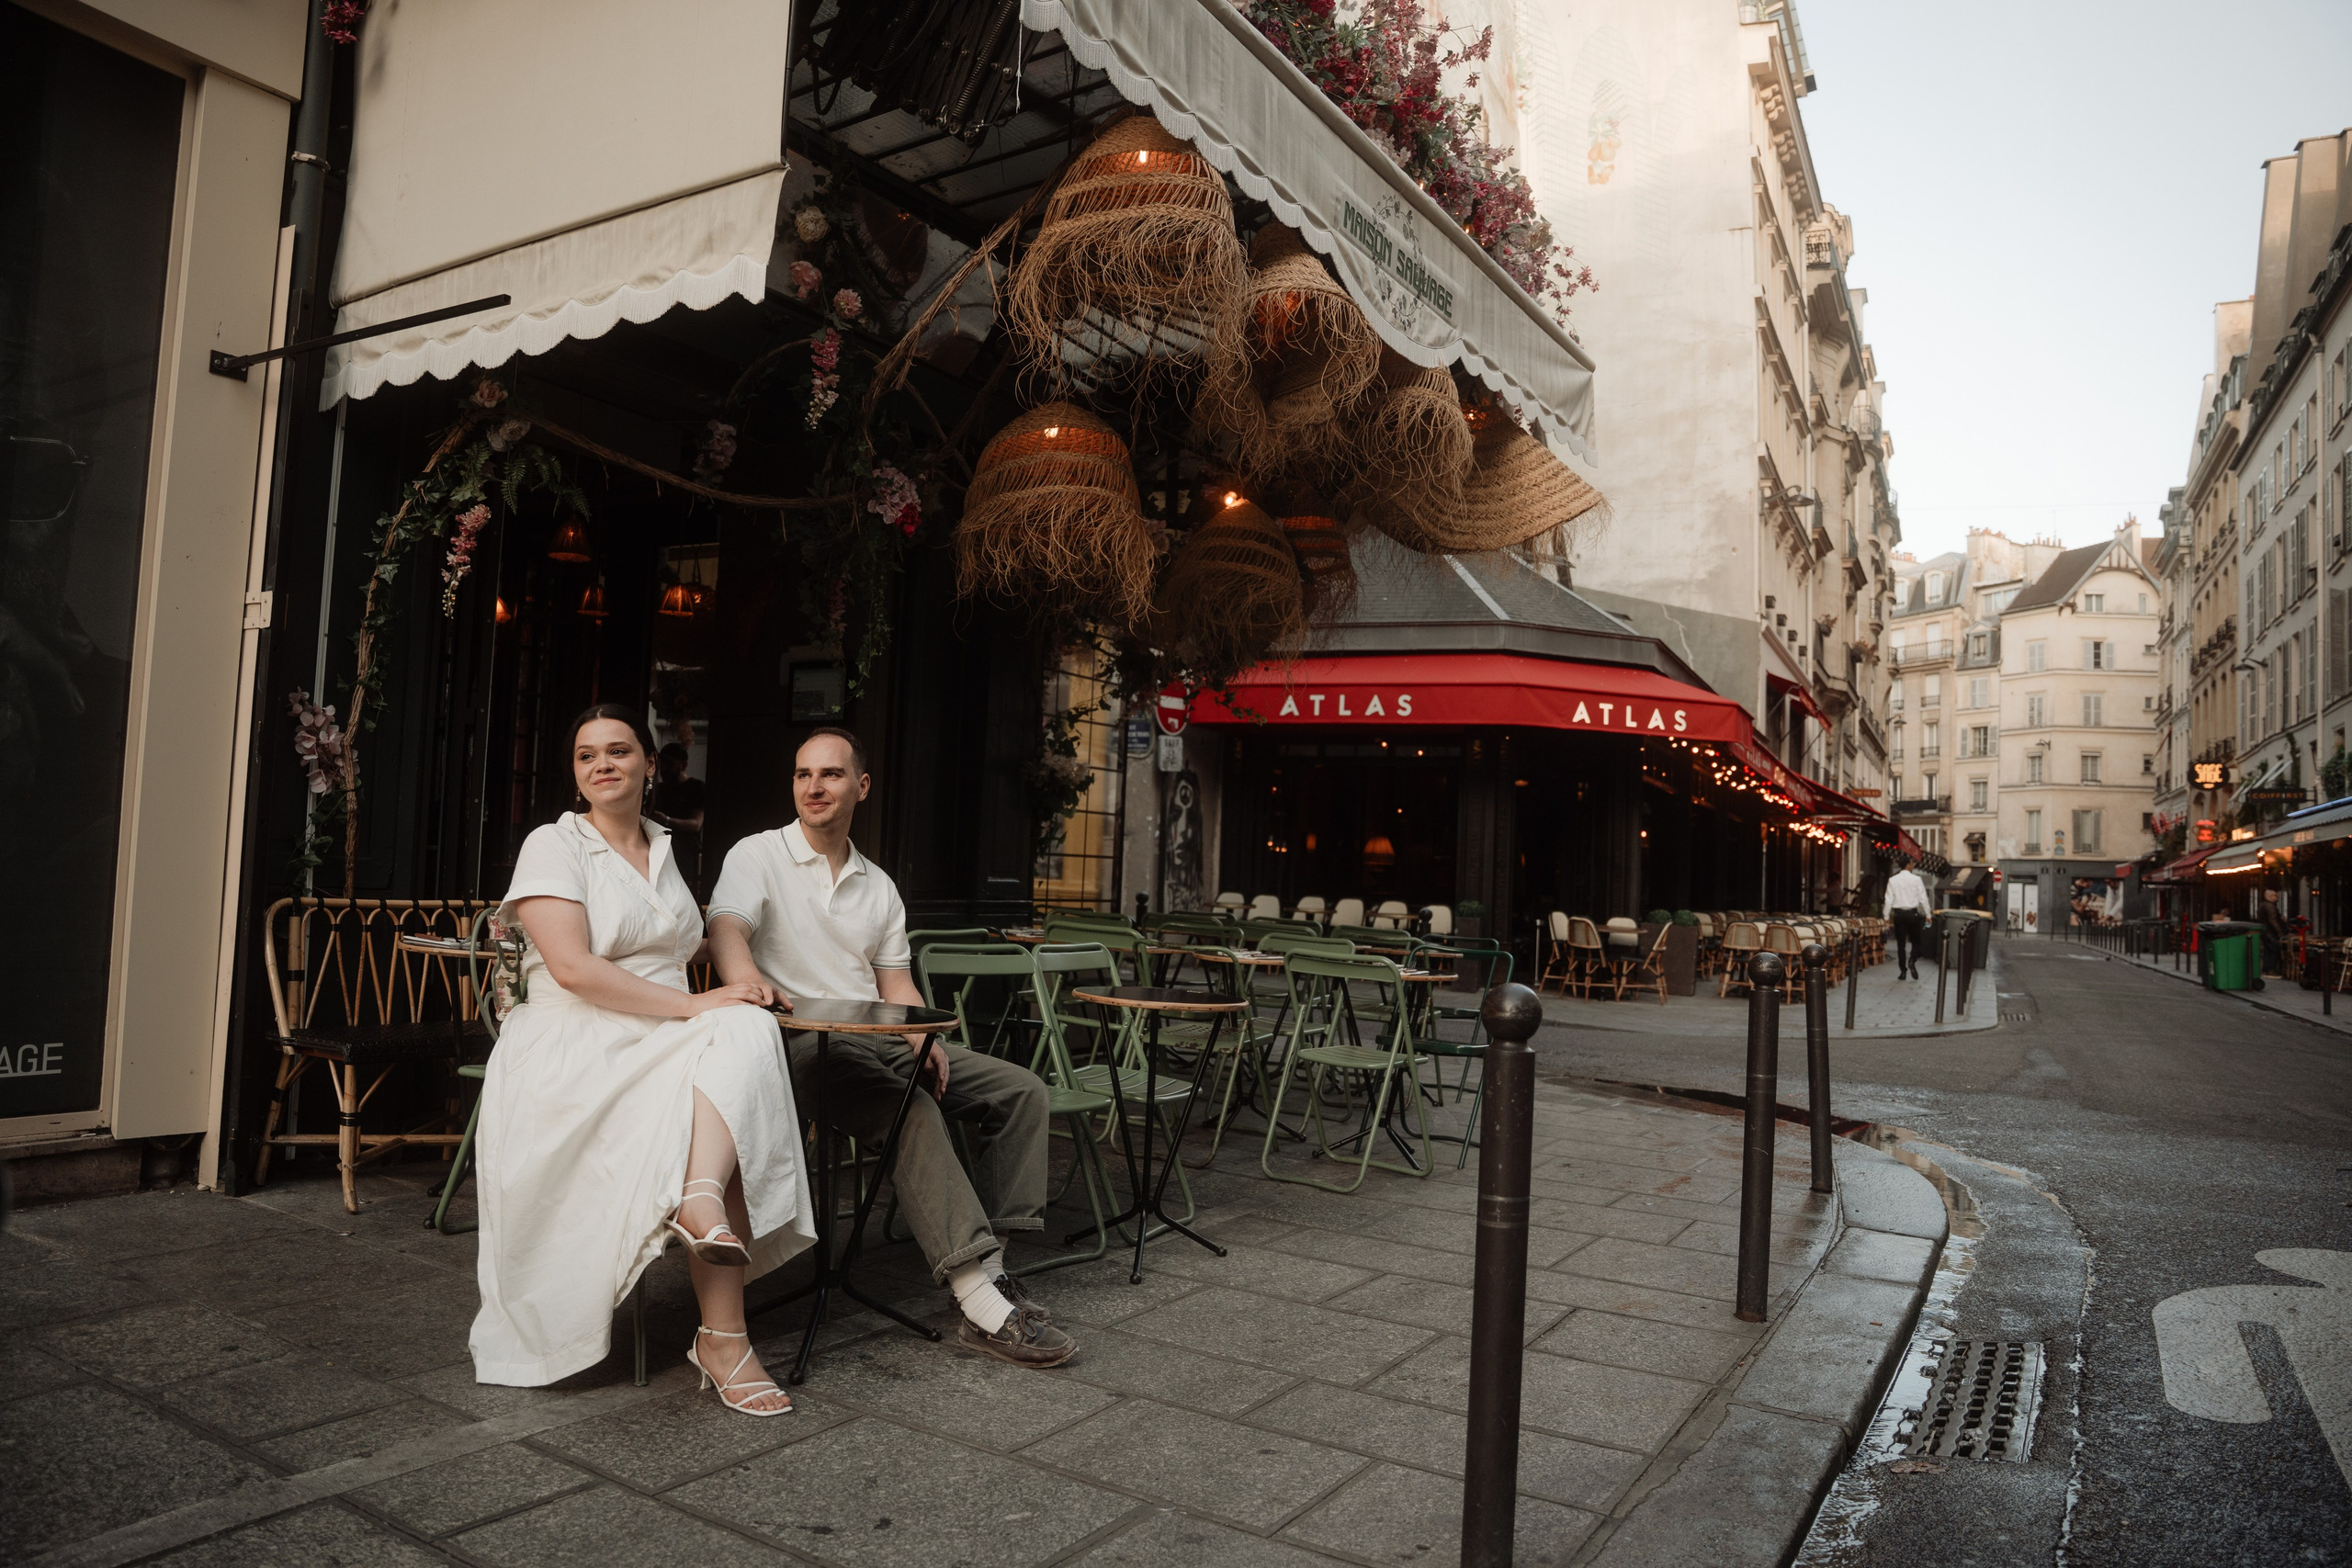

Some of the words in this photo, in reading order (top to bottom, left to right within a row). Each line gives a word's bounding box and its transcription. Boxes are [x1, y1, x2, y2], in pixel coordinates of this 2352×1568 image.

[1343, 201, 1393, 267] MAISON
[1279, 694, 1412, 716] ATLAS
[1572, 701, 1687, 732] ATLAS
